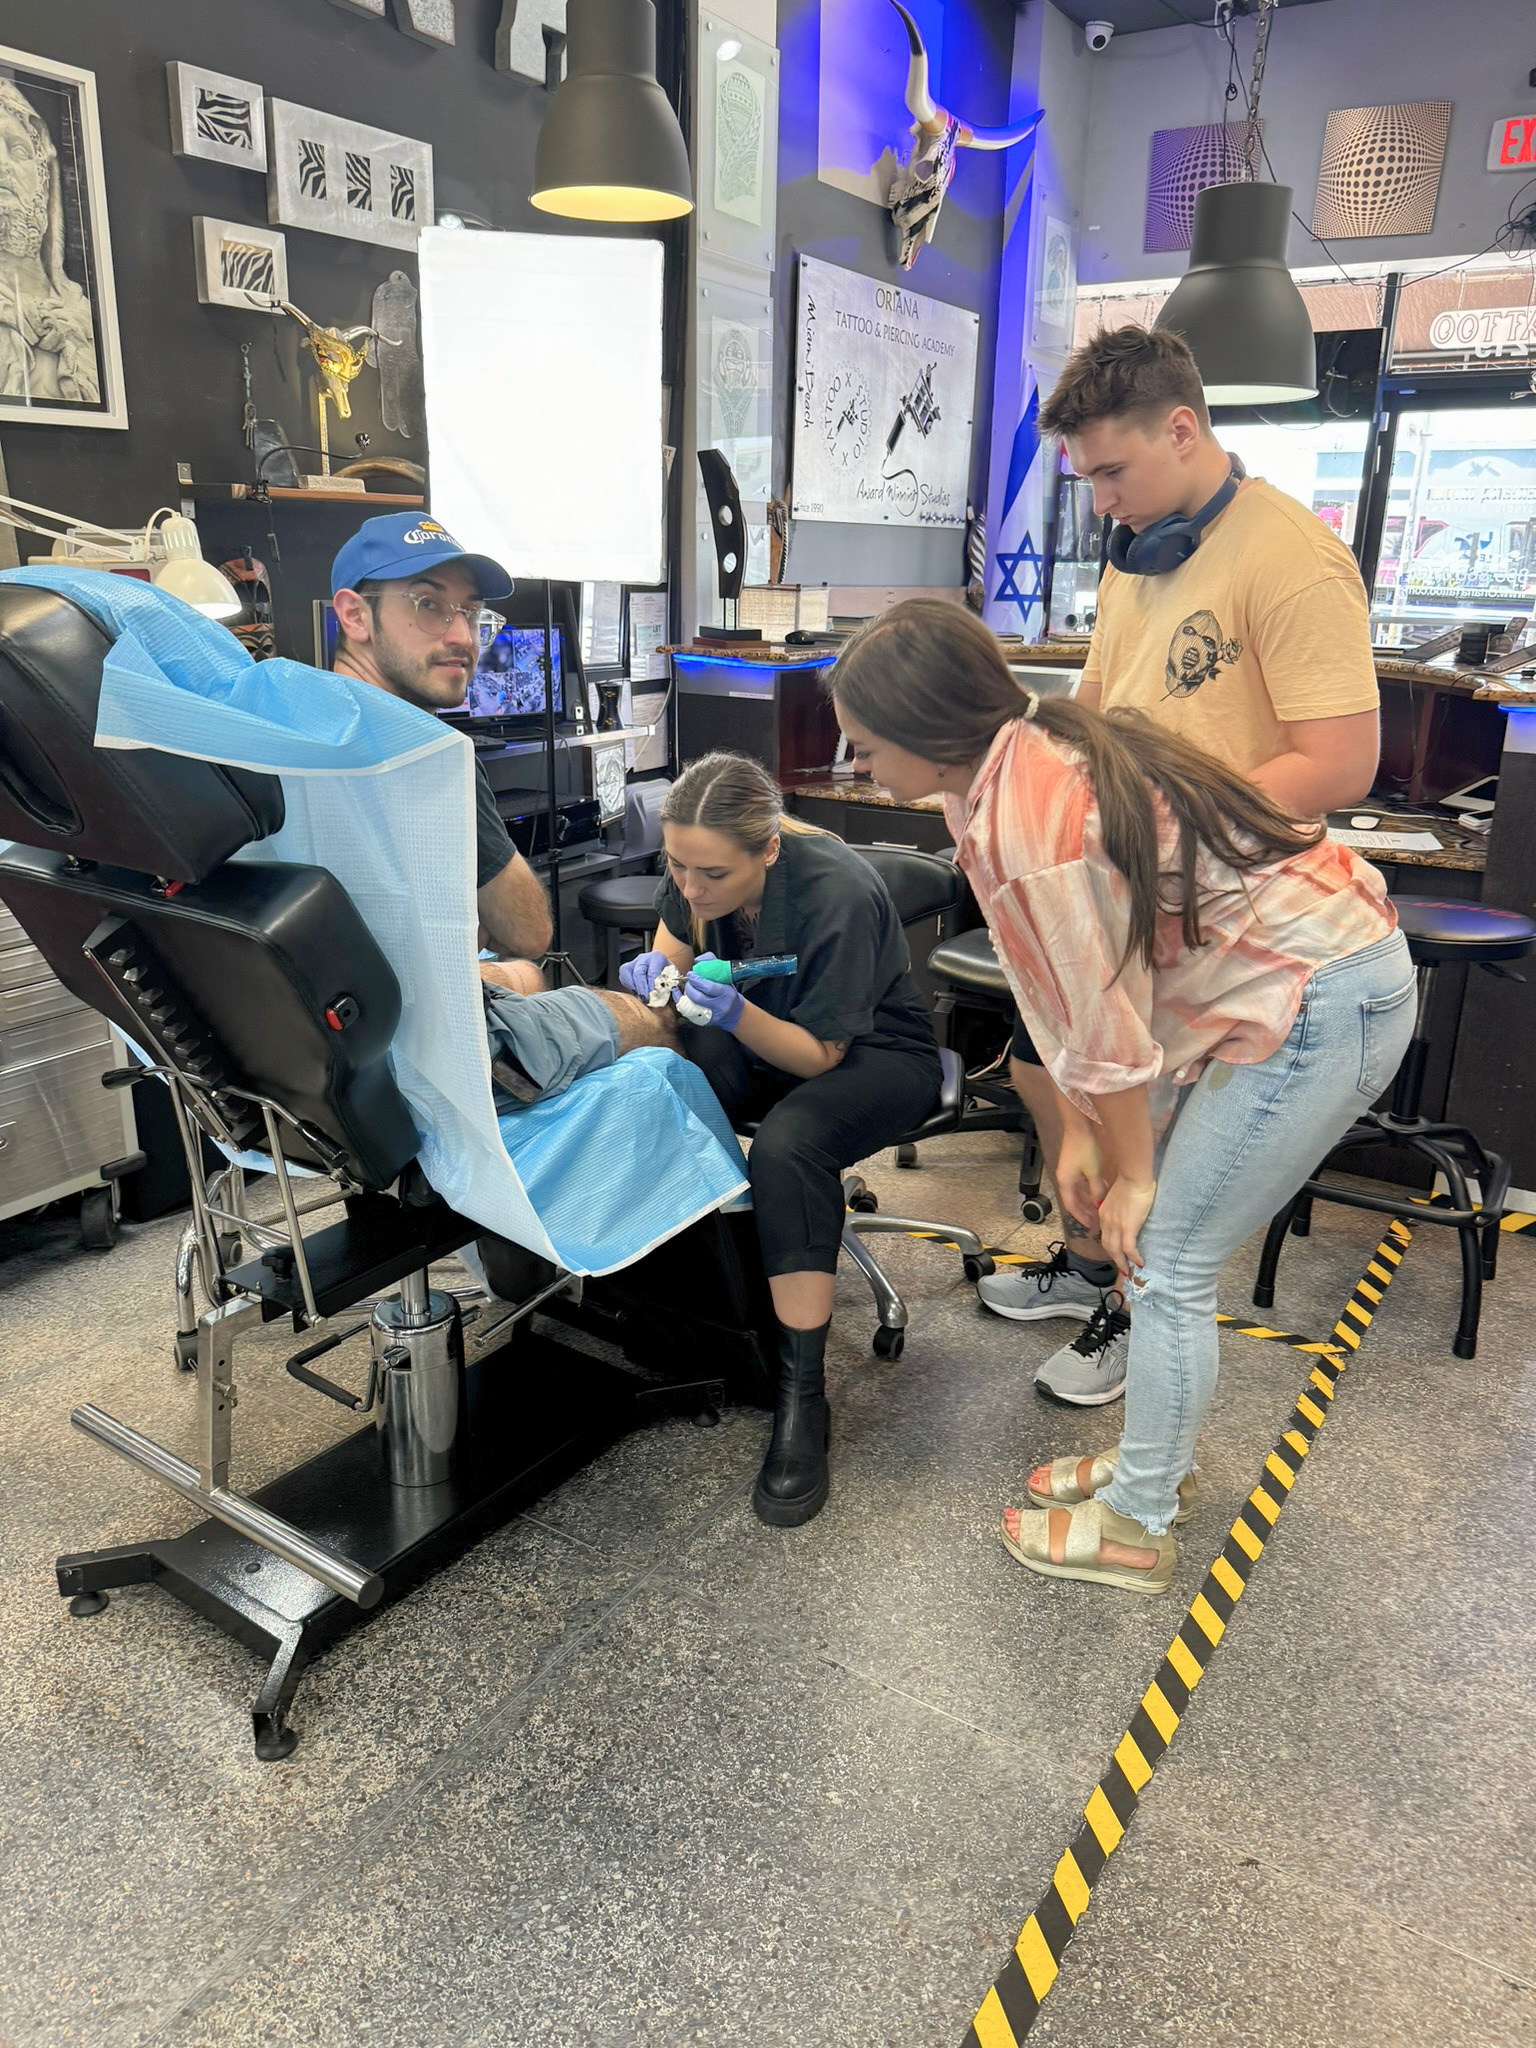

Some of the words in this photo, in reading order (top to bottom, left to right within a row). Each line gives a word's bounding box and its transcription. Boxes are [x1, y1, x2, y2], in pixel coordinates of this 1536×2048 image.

[1500, 117, 1536, 165] EX
[875, 287, 920, 320] ORIANA
[805, 294, 816, 368] Miami
[835, 310, 873, 335] TATTOO
[874, 321, 882, 338] &
[883, 324, 920, 349] PIERCING
[921, 337, 956, 357] ACADEMY
[803, 370, 816, 429] Beach
[856, 478, 886, 503] Award
[919, 483, 951, 507] Studios
